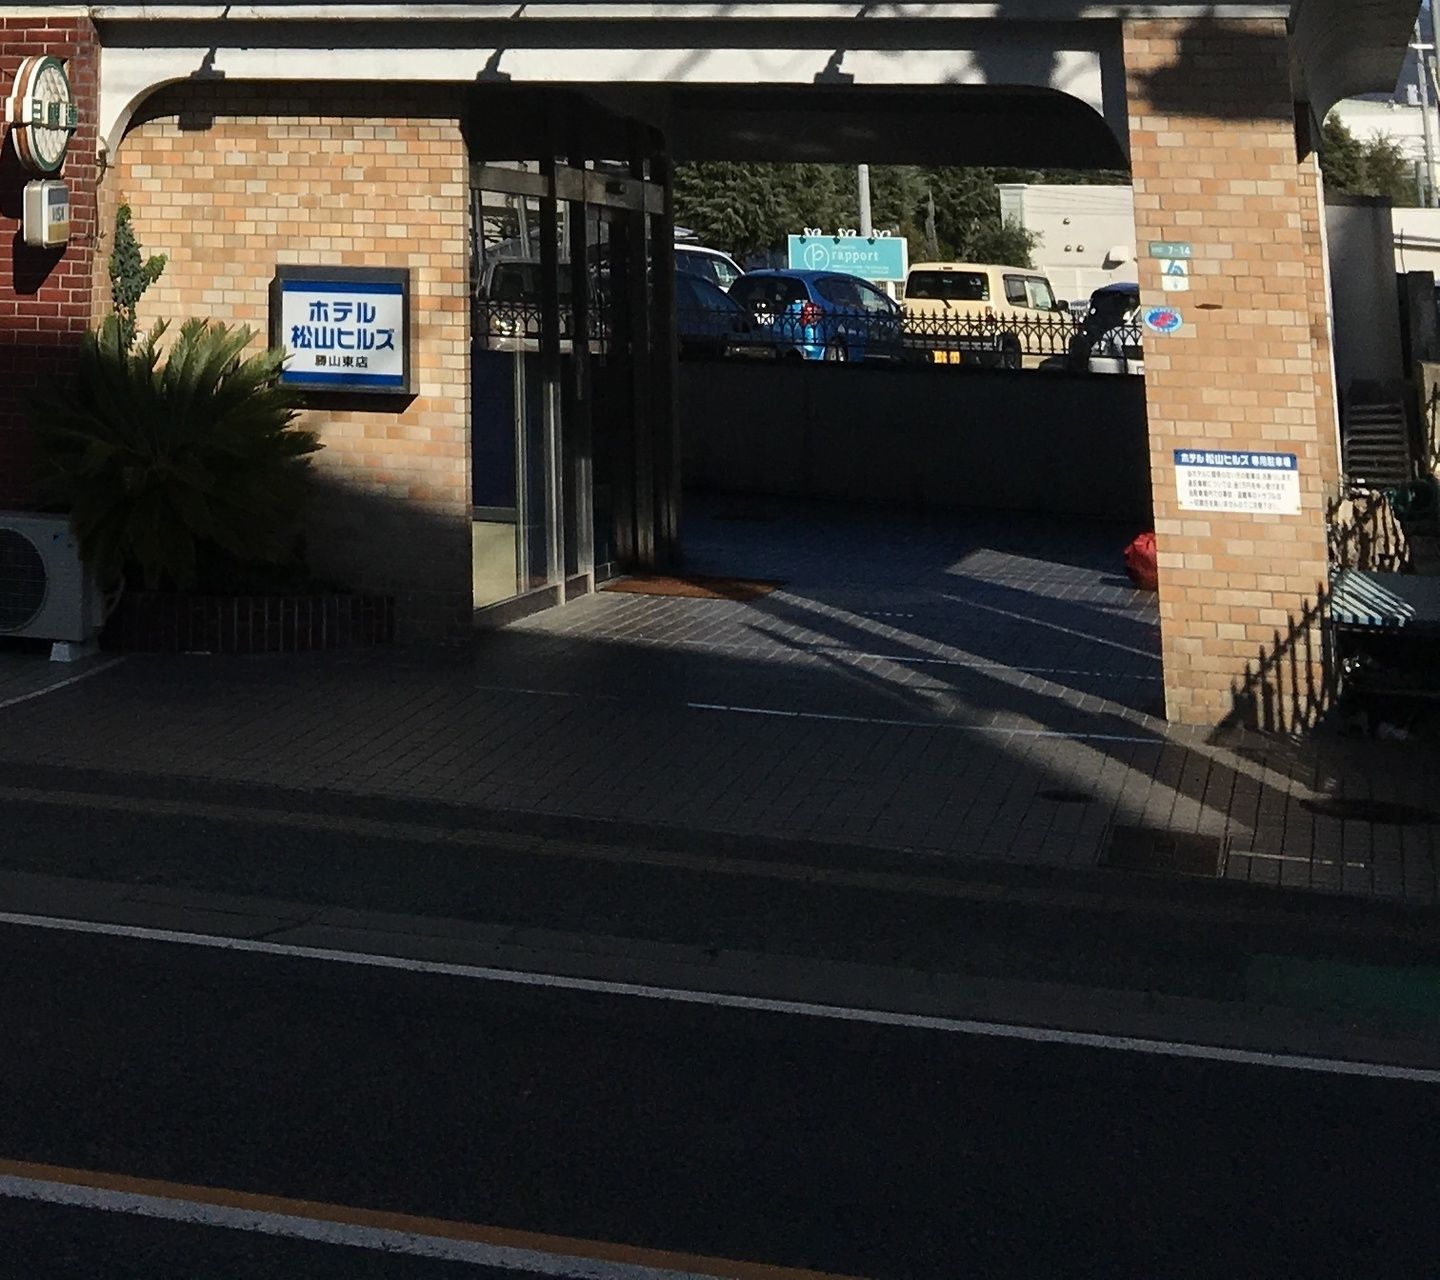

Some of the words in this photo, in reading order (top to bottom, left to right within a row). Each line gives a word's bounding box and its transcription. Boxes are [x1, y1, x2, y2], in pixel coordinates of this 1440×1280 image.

[831, 250, 879, 263] rapport
[309, 300, 376, 323] ホテル
[291, 325, 395, 351] 松山ヒルズ
[315, 354, 368, 368] 勝山東店
